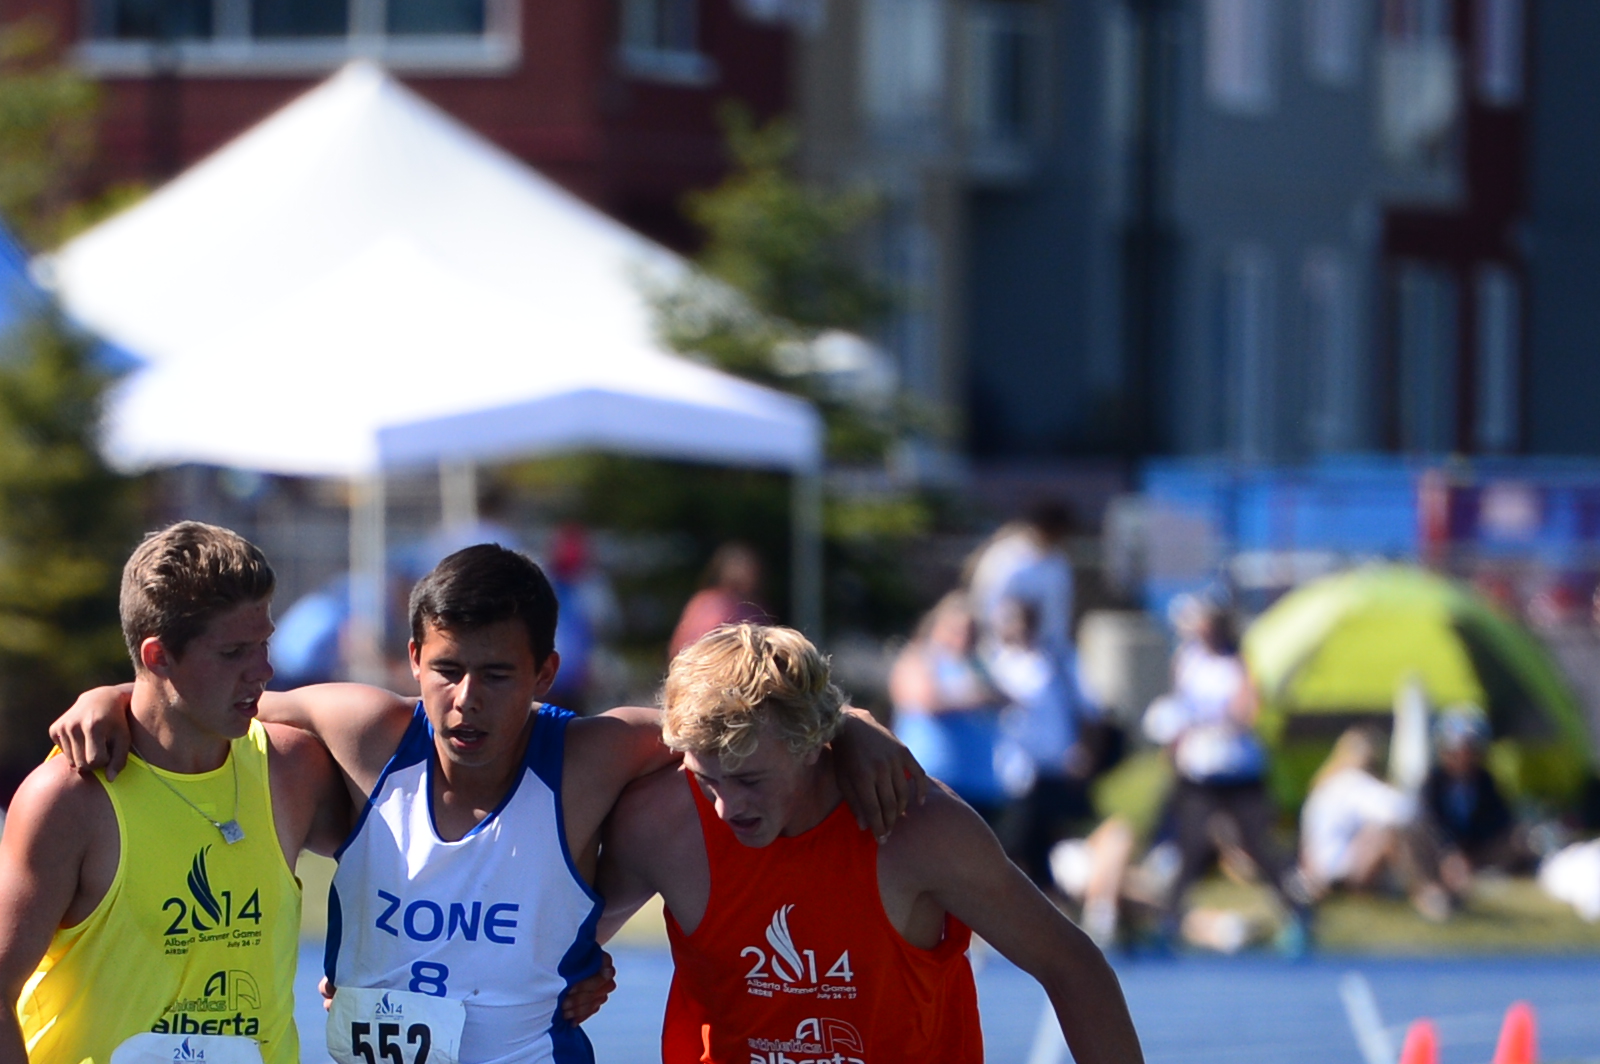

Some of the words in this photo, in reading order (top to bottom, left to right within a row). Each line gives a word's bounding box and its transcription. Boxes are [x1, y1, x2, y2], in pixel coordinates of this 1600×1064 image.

[375, 888, 520, 945] ZONE
[164, 936, 196, 948] Albera
[408, 960, 450, 998] 8
[151, 1012, 259, 1036] alberta
